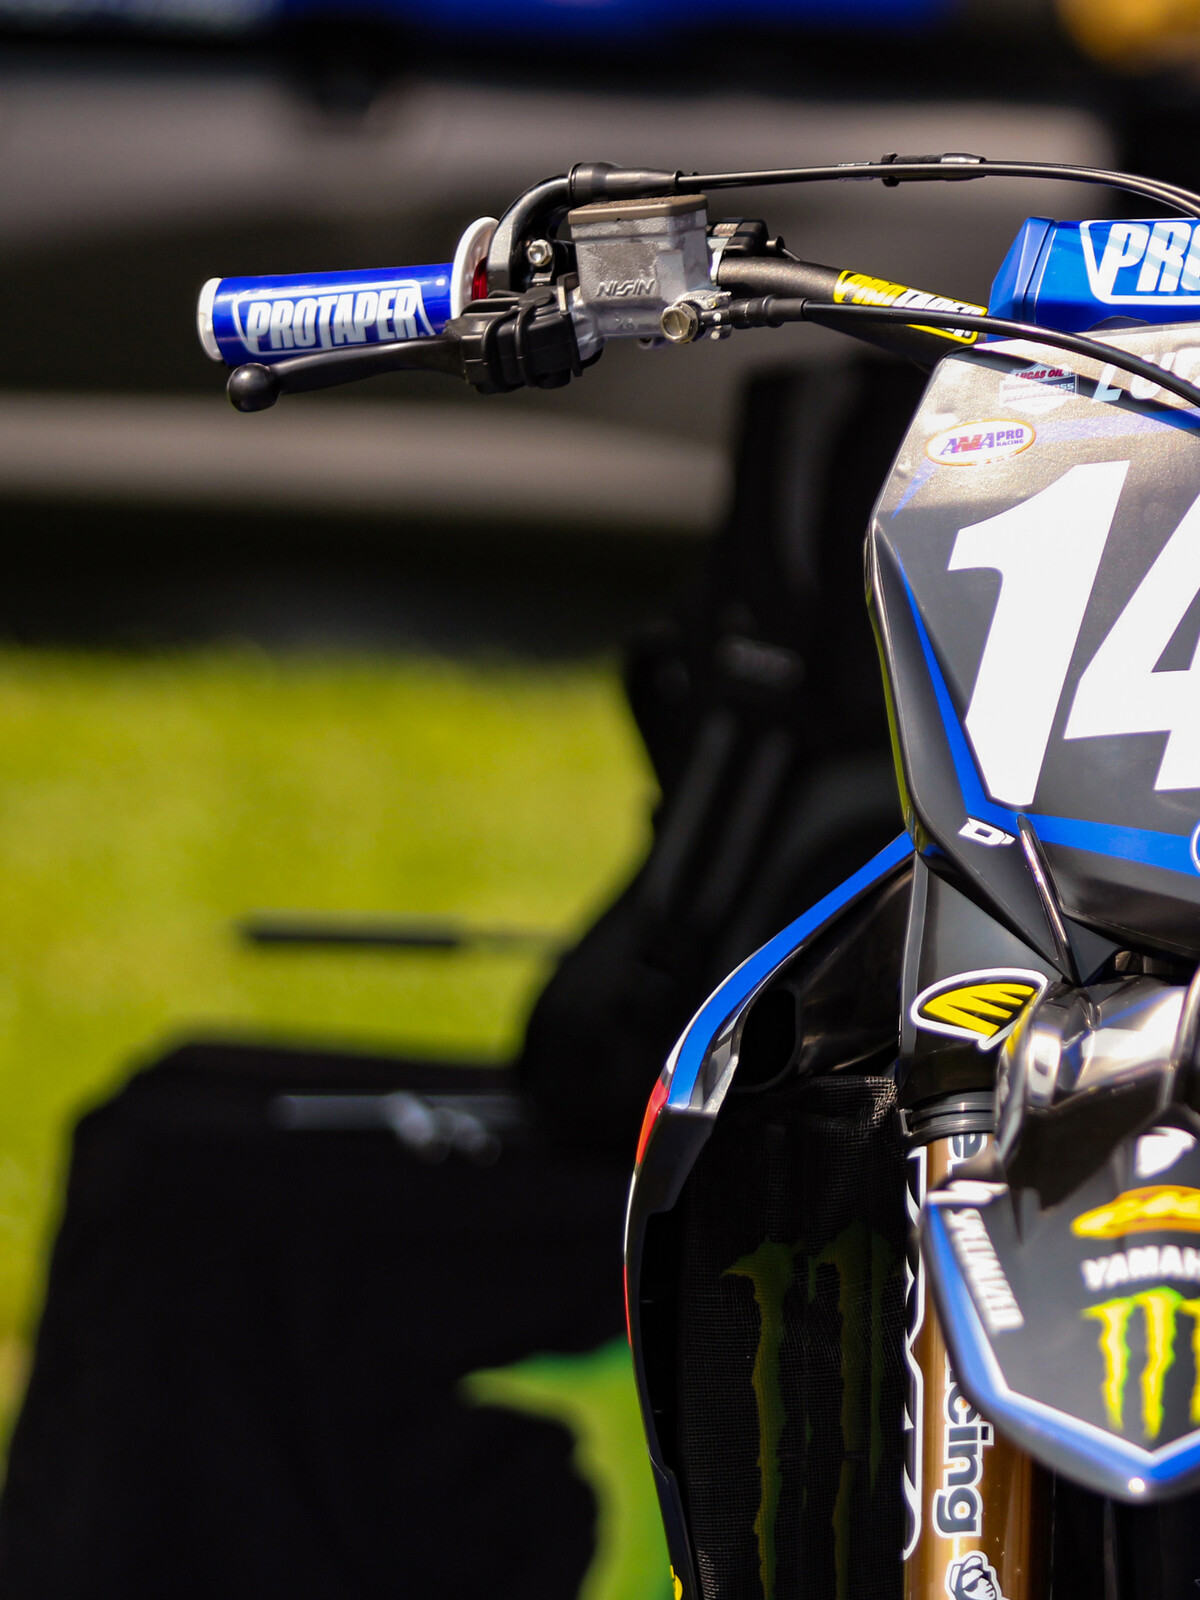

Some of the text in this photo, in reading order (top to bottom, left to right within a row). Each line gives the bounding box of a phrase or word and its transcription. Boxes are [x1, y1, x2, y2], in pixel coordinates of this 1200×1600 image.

[248, 285, 423, 351] PROTAPER
[1014, 370, 1047, 380] UCAS
[996, 428, 1024, 441] PRO
